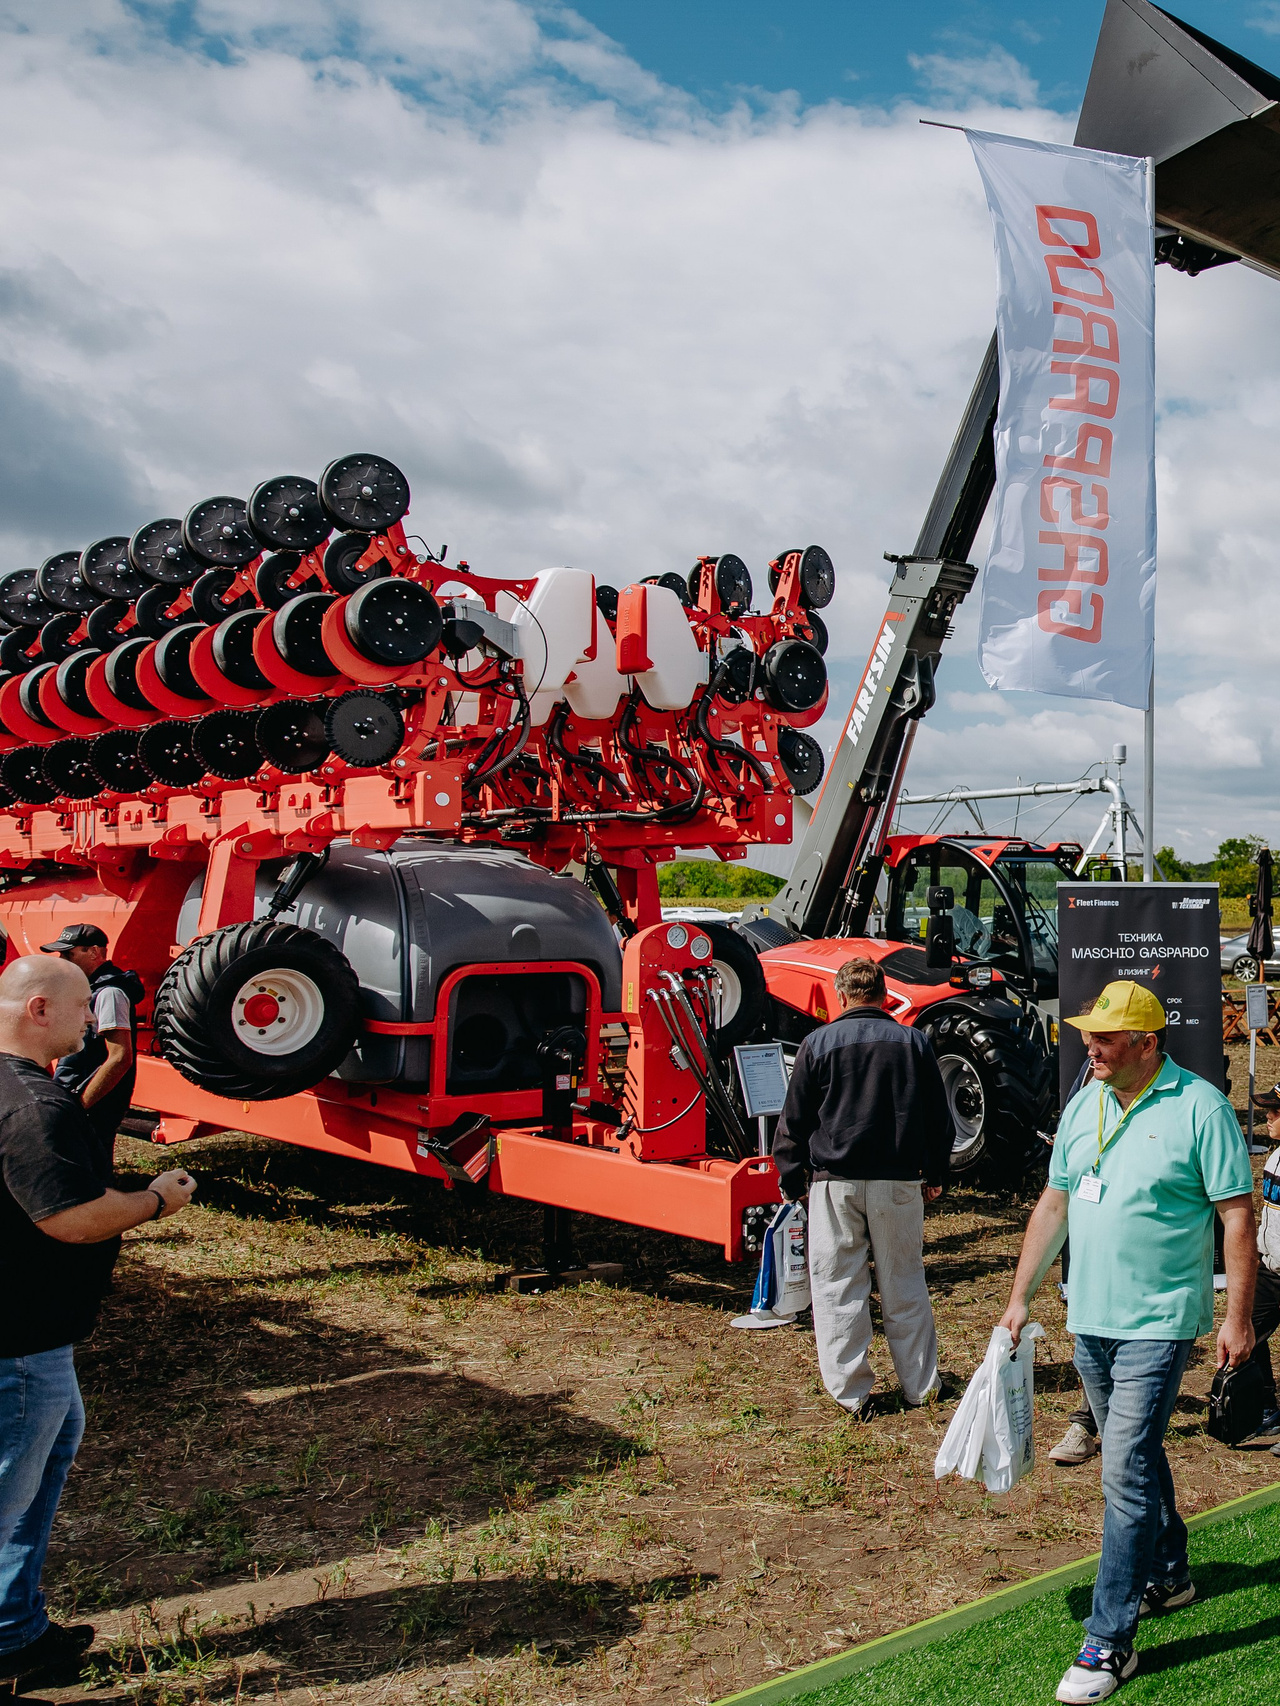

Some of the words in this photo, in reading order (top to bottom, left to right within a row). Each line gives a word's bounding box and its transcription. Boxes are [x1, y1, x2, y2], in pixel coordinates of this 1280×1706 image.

[1076, 899, 1094, 907] Fleet
[1094, 899, 1119, 907] Finance
[1118, 933, 1163, 942] ТЕХНИКА
[1071, 947, 1135, 959] MASCHIO
[1139, 947, 1210, 958] GASPARDO
[1124, 968, 1150, 976] ЛИЗИНГ
